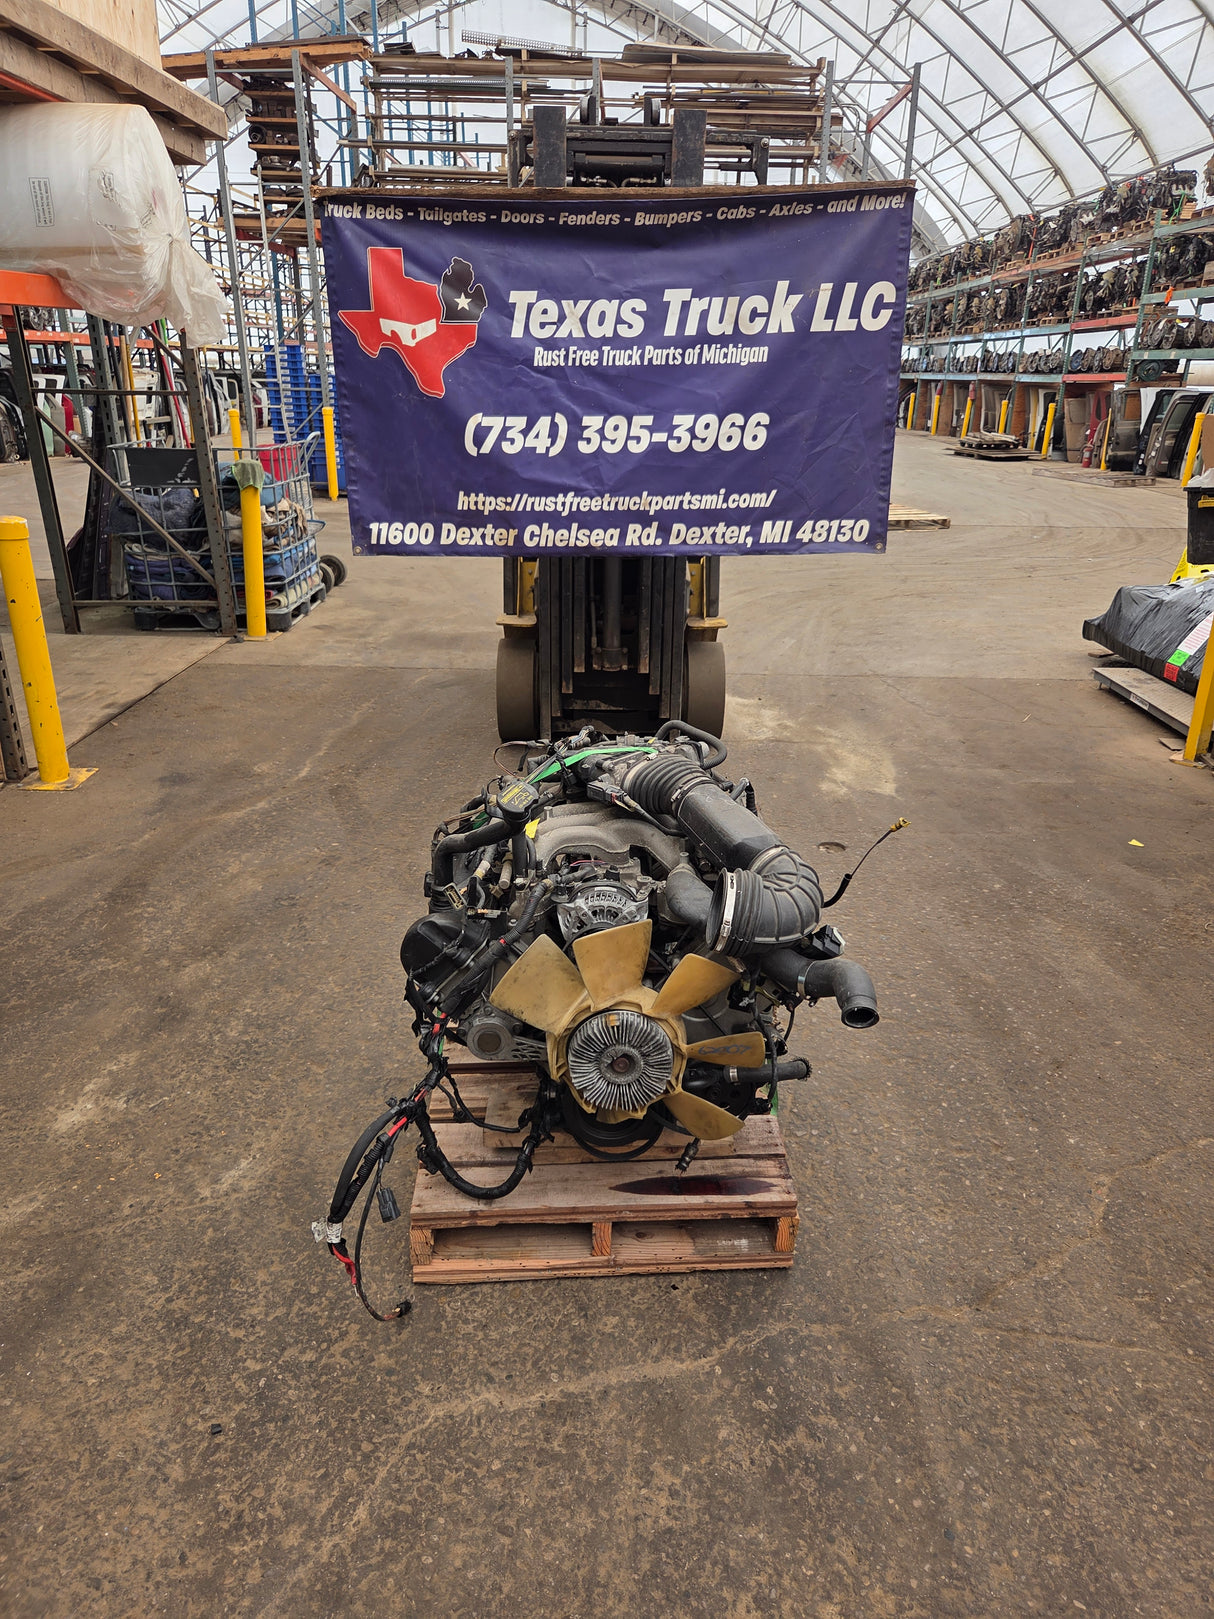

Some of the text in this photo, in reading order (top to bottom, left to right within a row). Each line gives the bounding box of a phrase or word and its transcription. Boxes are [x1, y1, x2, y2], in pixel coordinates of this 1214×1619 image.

[365, 203, 404, 220] Beds
[418, 207, 486, 226] Tailgates
[500, 210, 545, 224] Doors
[558, 211, 621, 225] Fenders
[634, 210, 703, 228] Bumpers
[716, 204, 756, 220] Cabs
[768, 201, 814, 217] Axles
[827, 197, 859, 213] and
[859, 192, 907, 212] More!
[508, 280, 897, 339] Texas Truck LLC
[533, 343, 769, 367] Rust Free Truck Parts of Michigan
[464, 412, 770, 457] (734) 395-3966
[457, 488, 777, 517] https://rustfreetruckpartsmi.com/
[369, 519, 870, 548] 11600 Dexter Chelsea Rd. Dexter, MI 48130
